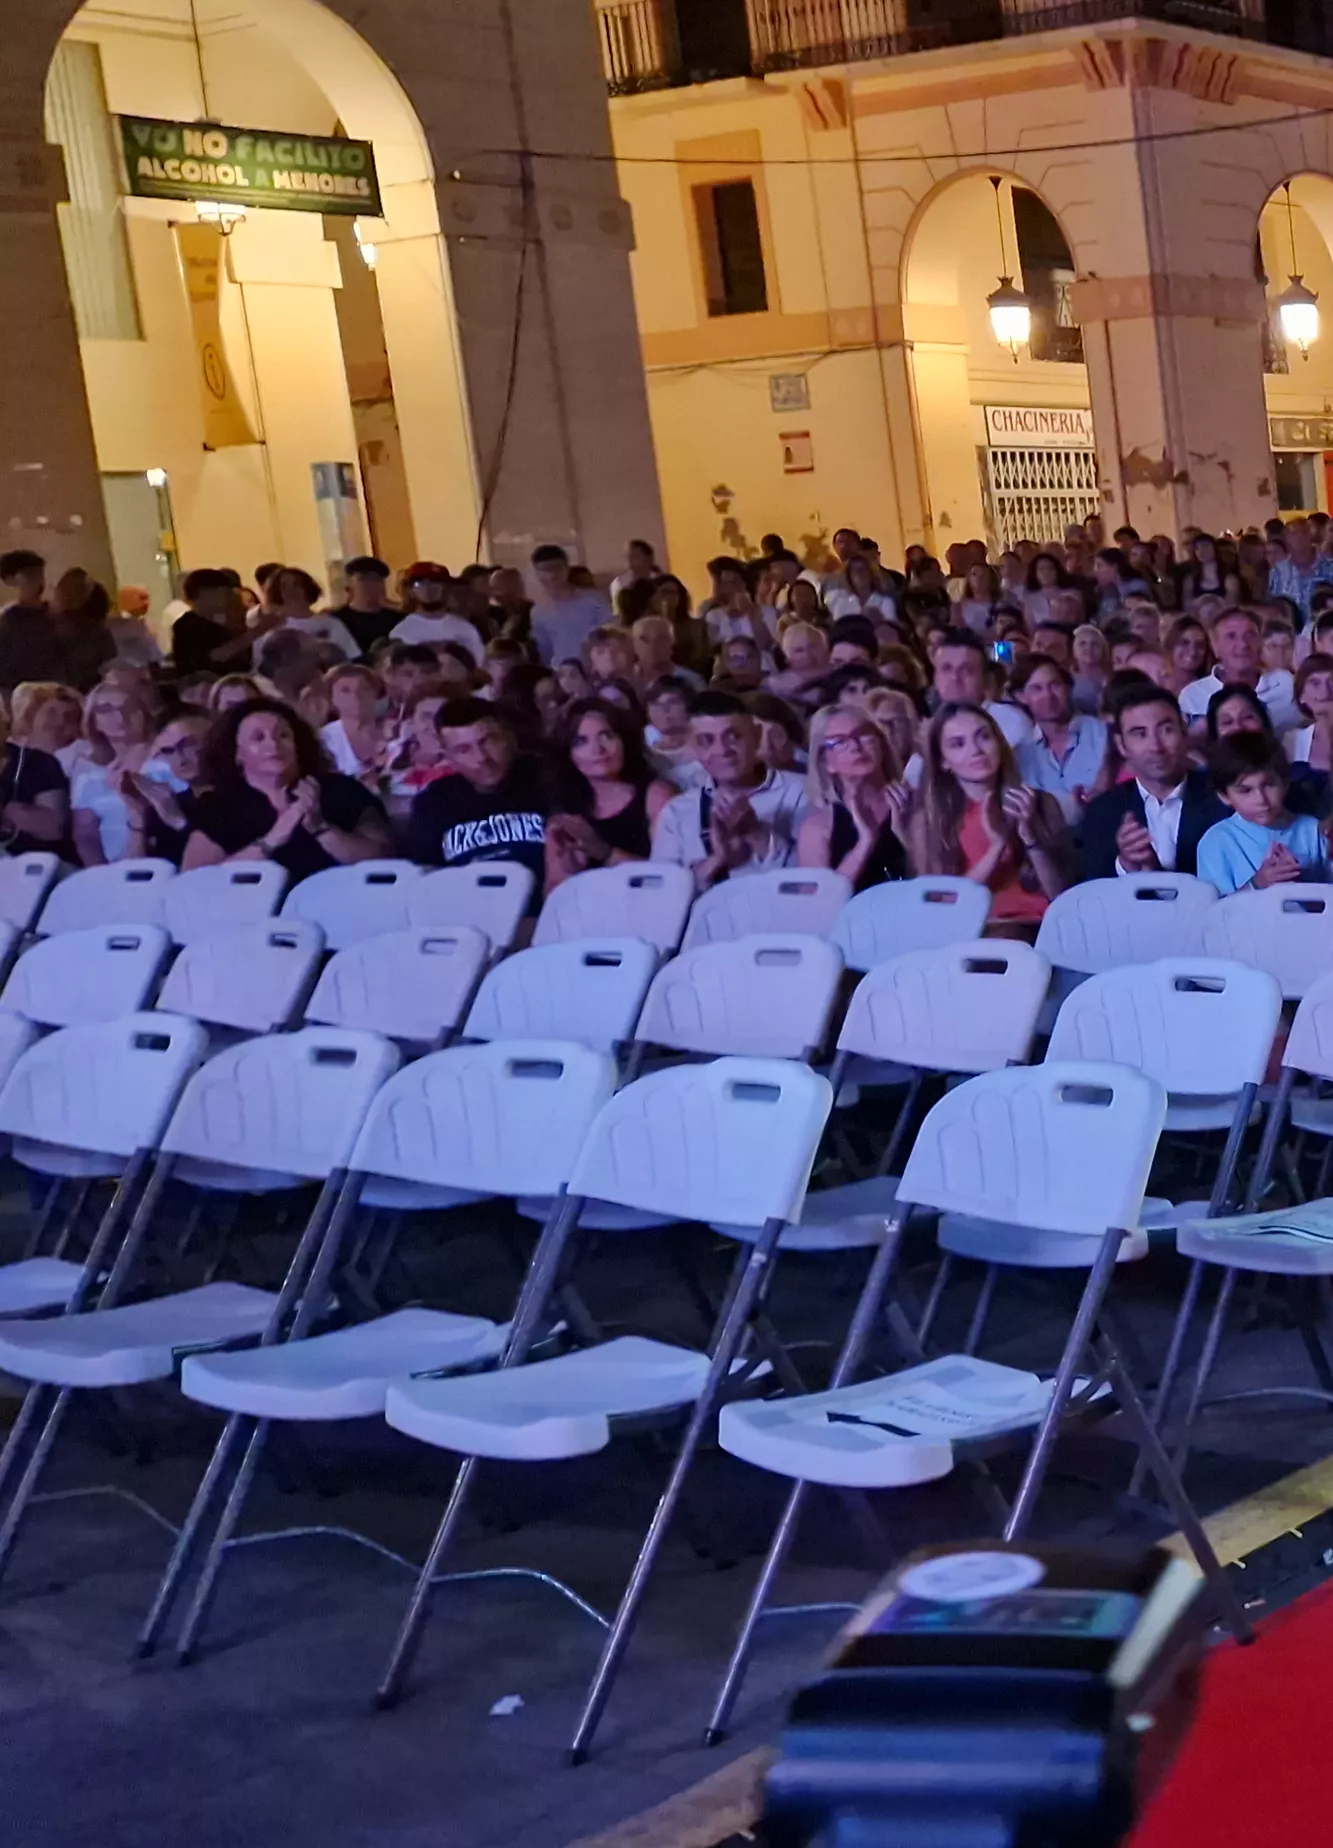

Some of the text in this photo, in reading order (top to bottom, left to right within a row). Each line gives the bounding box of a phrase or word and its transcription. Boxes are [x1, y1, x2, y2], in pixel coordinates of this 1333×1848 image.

[131, 124, 367, 171] YO NO FACILITO
[137, 156, 250, 187] ALCOHOL
[254, 167, 271, 188] A
[272, 169, 371, 197] MENORES
[991, 409, 1086, 434] CHACINERIA
